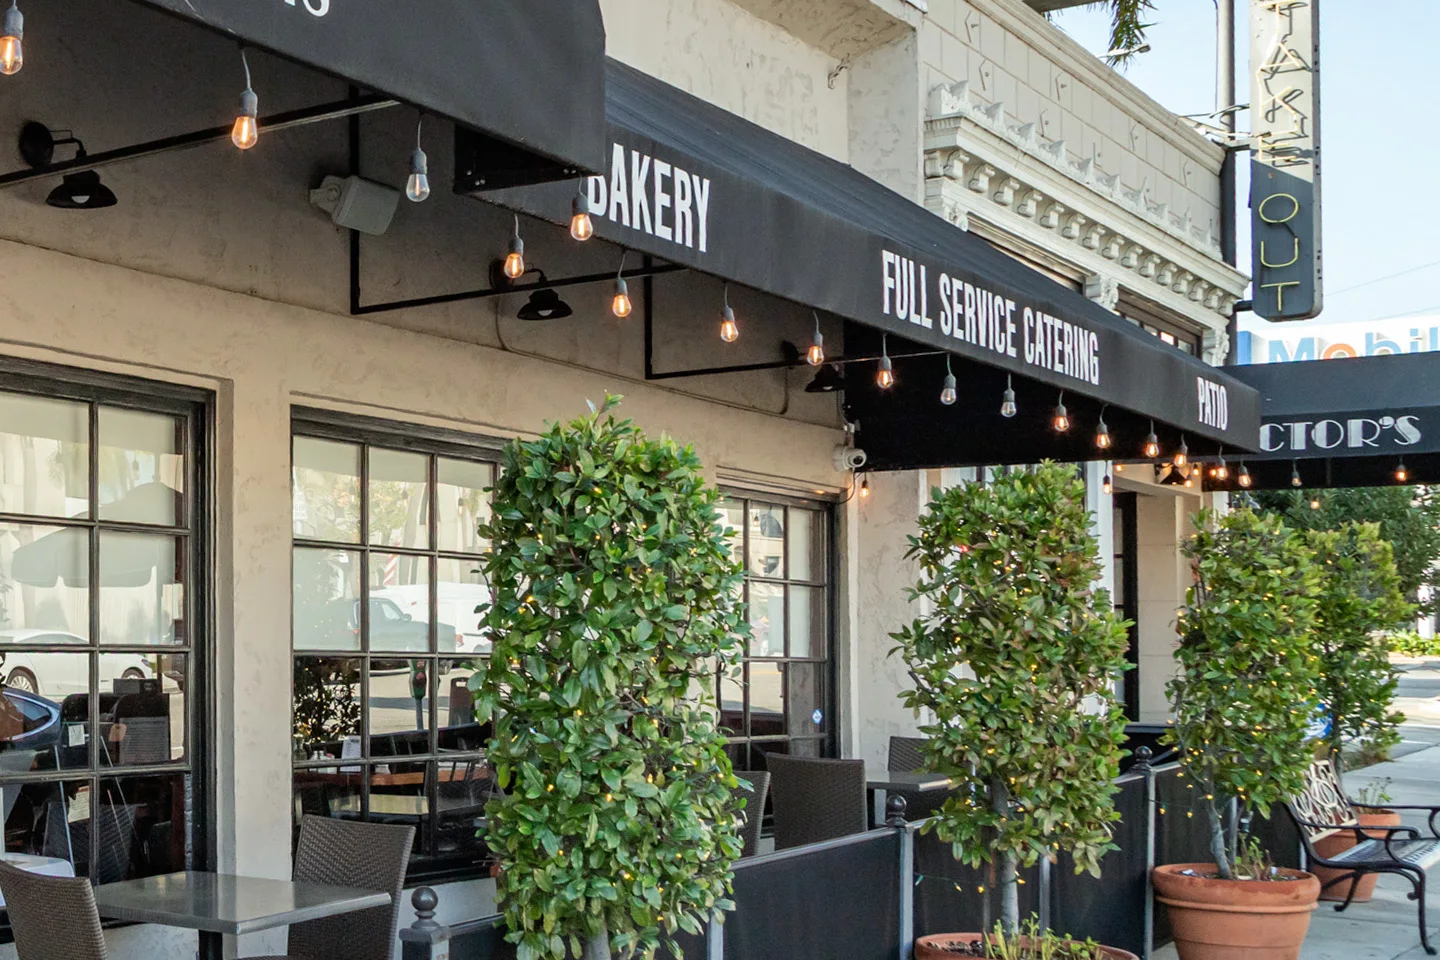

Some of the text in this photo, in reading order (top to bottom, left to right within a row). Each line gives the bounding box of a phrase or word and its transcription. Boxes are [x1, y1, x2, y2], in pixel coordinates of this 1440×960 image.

[1259, 193, 1300, 312] OUT
[882, 249, 1100, 386] FULL SERVICE CATERING
[1196, 376, 1228, 431] PATIO
